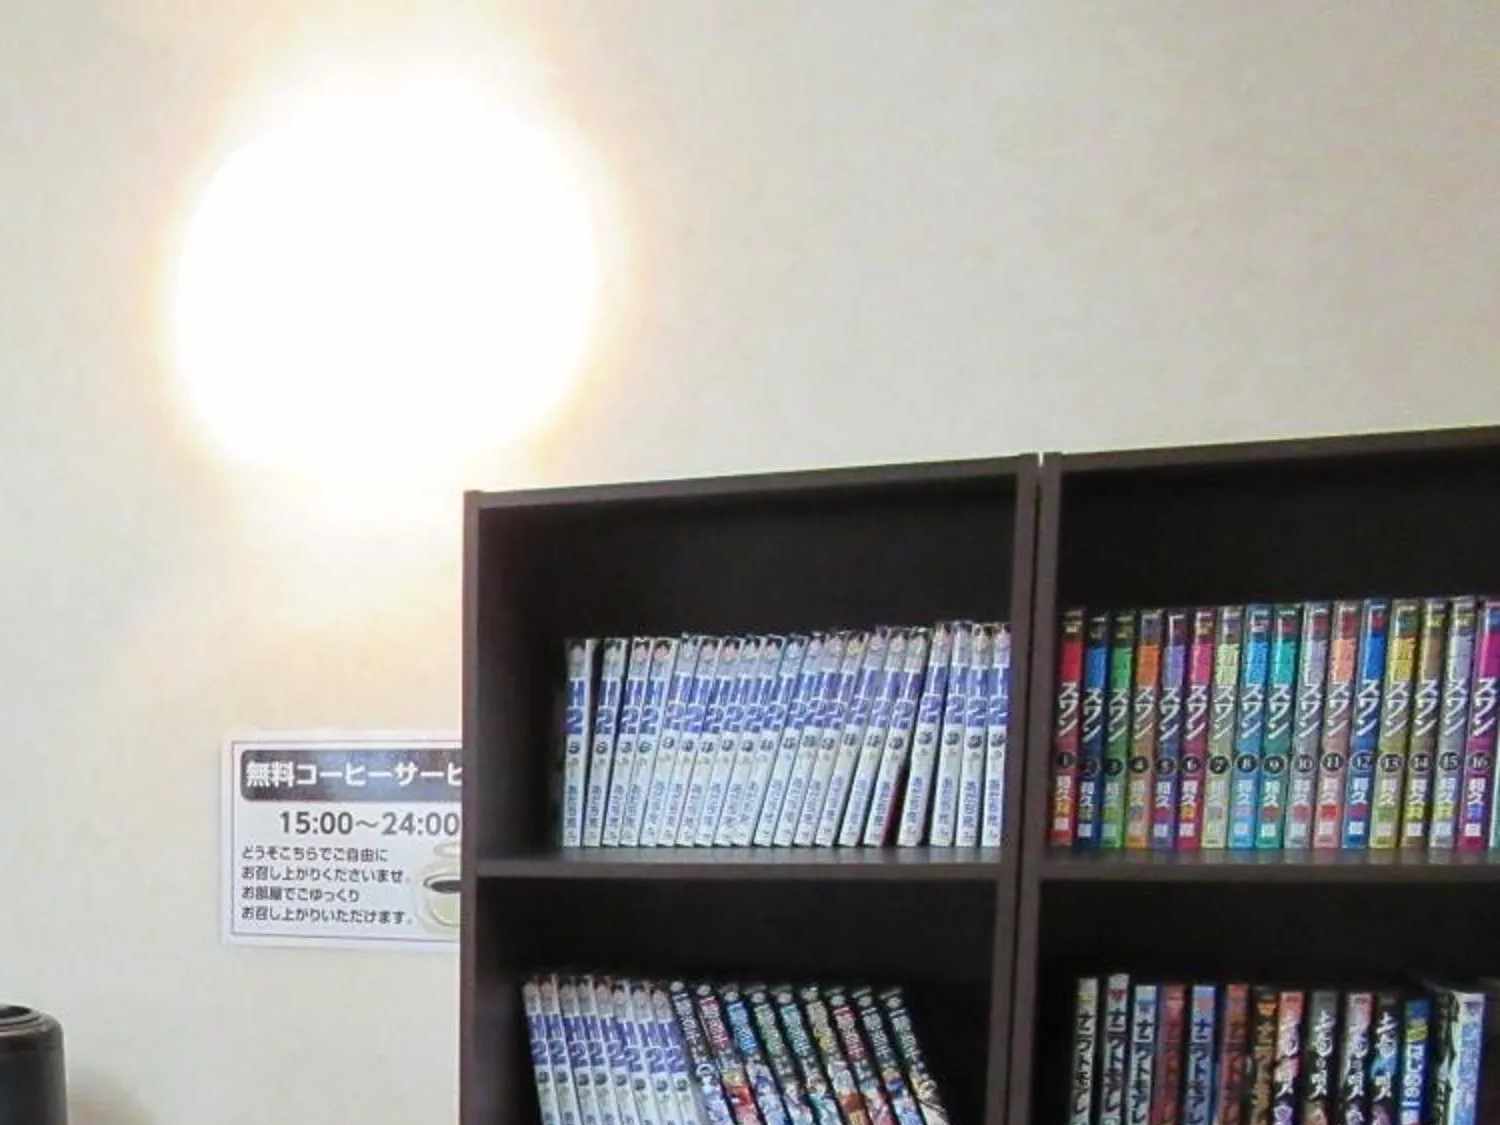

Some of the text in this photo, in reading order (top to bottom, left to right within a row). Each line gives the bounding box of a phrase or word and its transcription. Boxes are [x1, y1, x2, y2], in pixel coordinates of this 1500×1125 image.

[241, 846, 389, 862] どうぞこちらでご自由に
[241, 886, 360, 902] お部屋でごゆっくり
